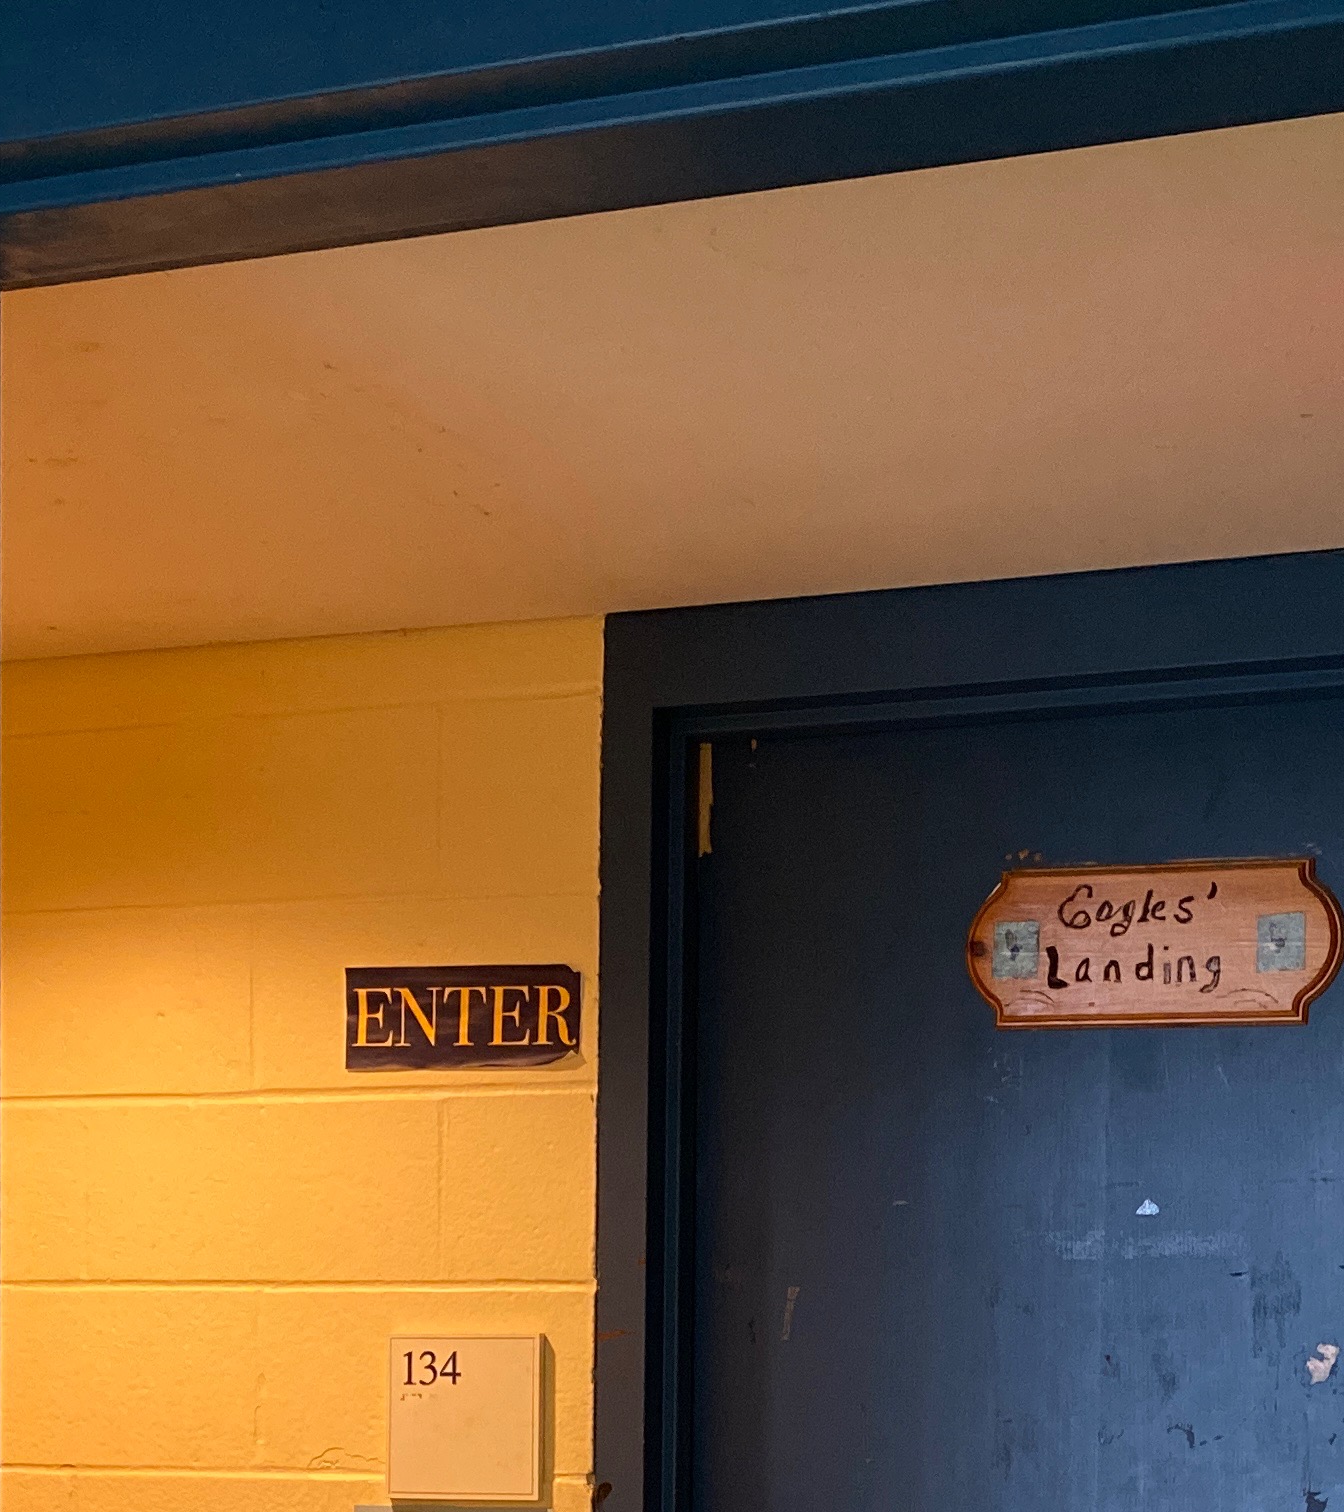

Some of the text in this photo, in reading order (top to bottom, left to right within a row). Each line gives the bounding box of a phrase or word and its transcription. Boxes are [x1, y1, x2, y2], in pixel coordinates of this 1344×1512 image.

[1045, 943, 1222, 993] Landing
[351, 985, 577, 1047] ENTER
[402, 1350, 462, 1386] 134
